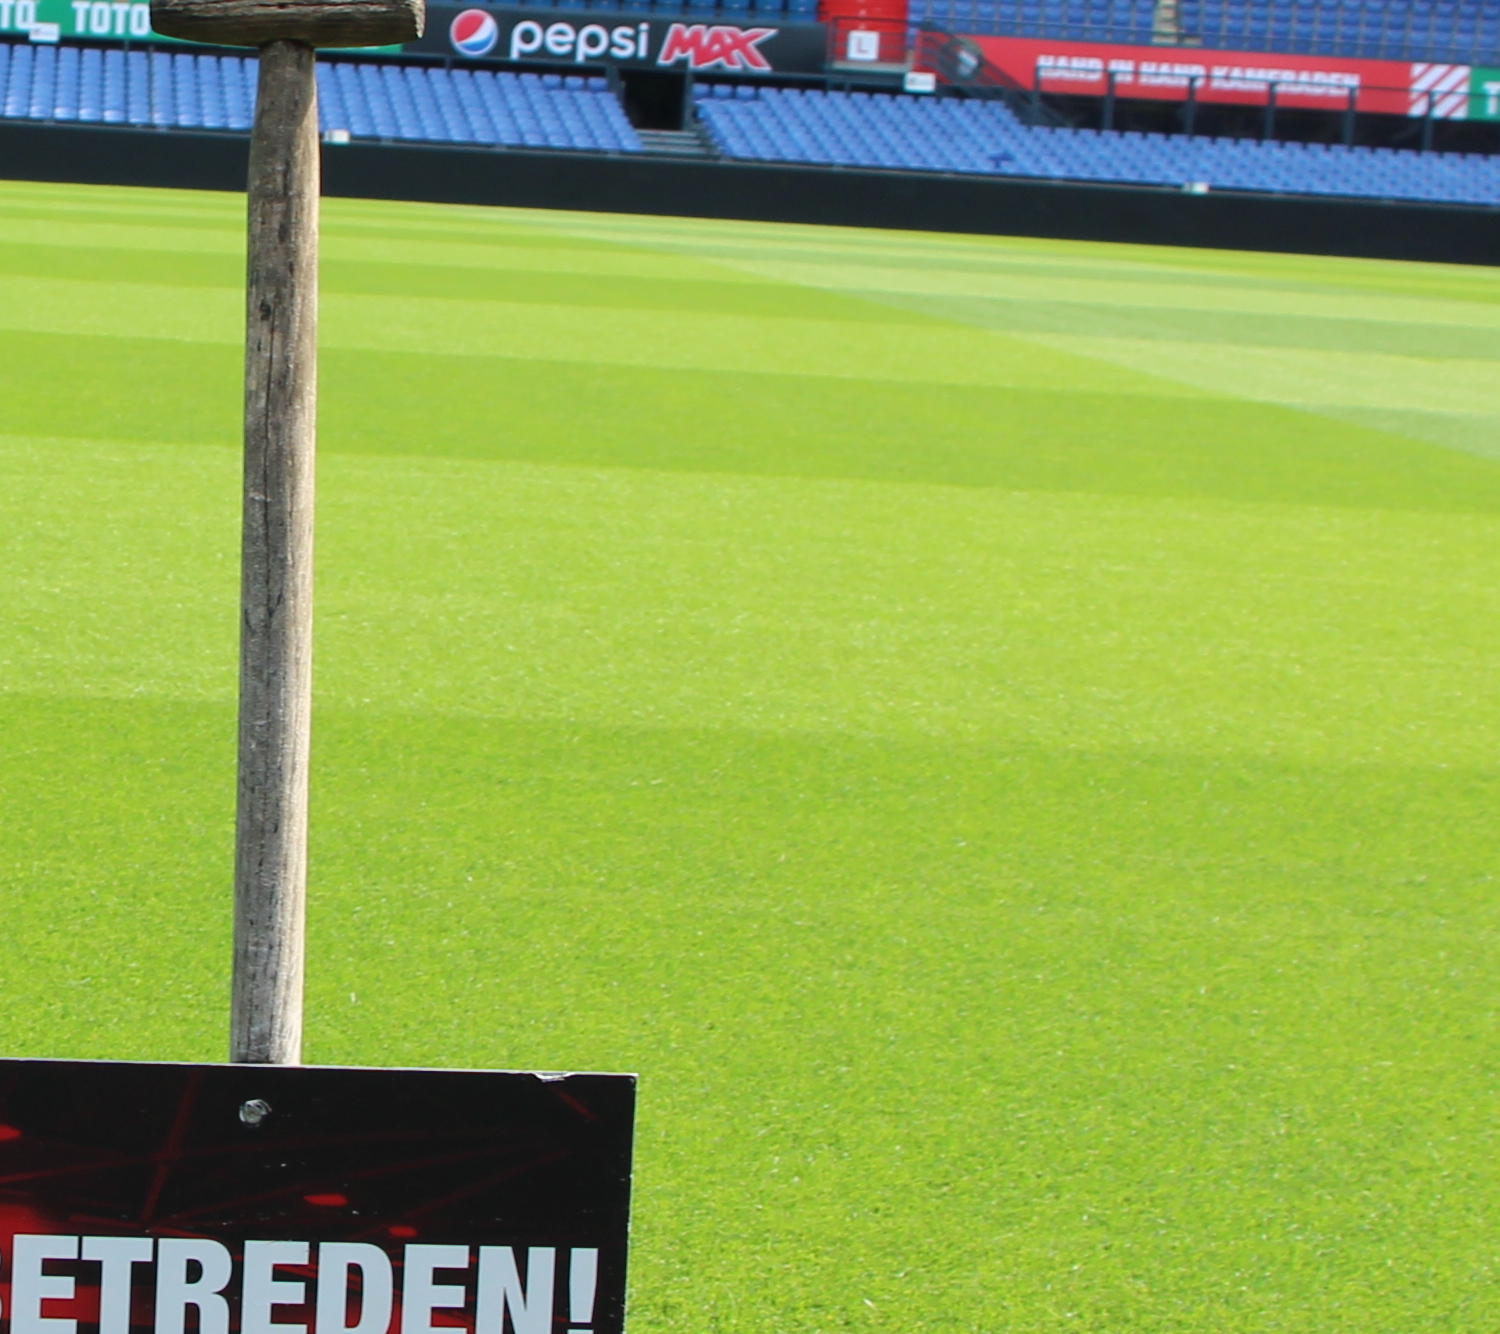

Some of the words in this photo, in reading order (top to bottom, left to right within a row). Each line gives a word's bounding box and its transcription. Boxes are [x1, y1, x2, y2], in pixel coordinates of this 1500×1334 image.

[71, 0, 150, 36] TOTO
[510, 19, 650, 63] pepsi
[657, 22, 780, 71] MAX
[1037, 54, 1103, 81] HAND
[1109, 59, 1135, 84] IN
[1139, 61, 1207, 88] HAND
[1210, 65, 1360, 97] KAMERADEN
